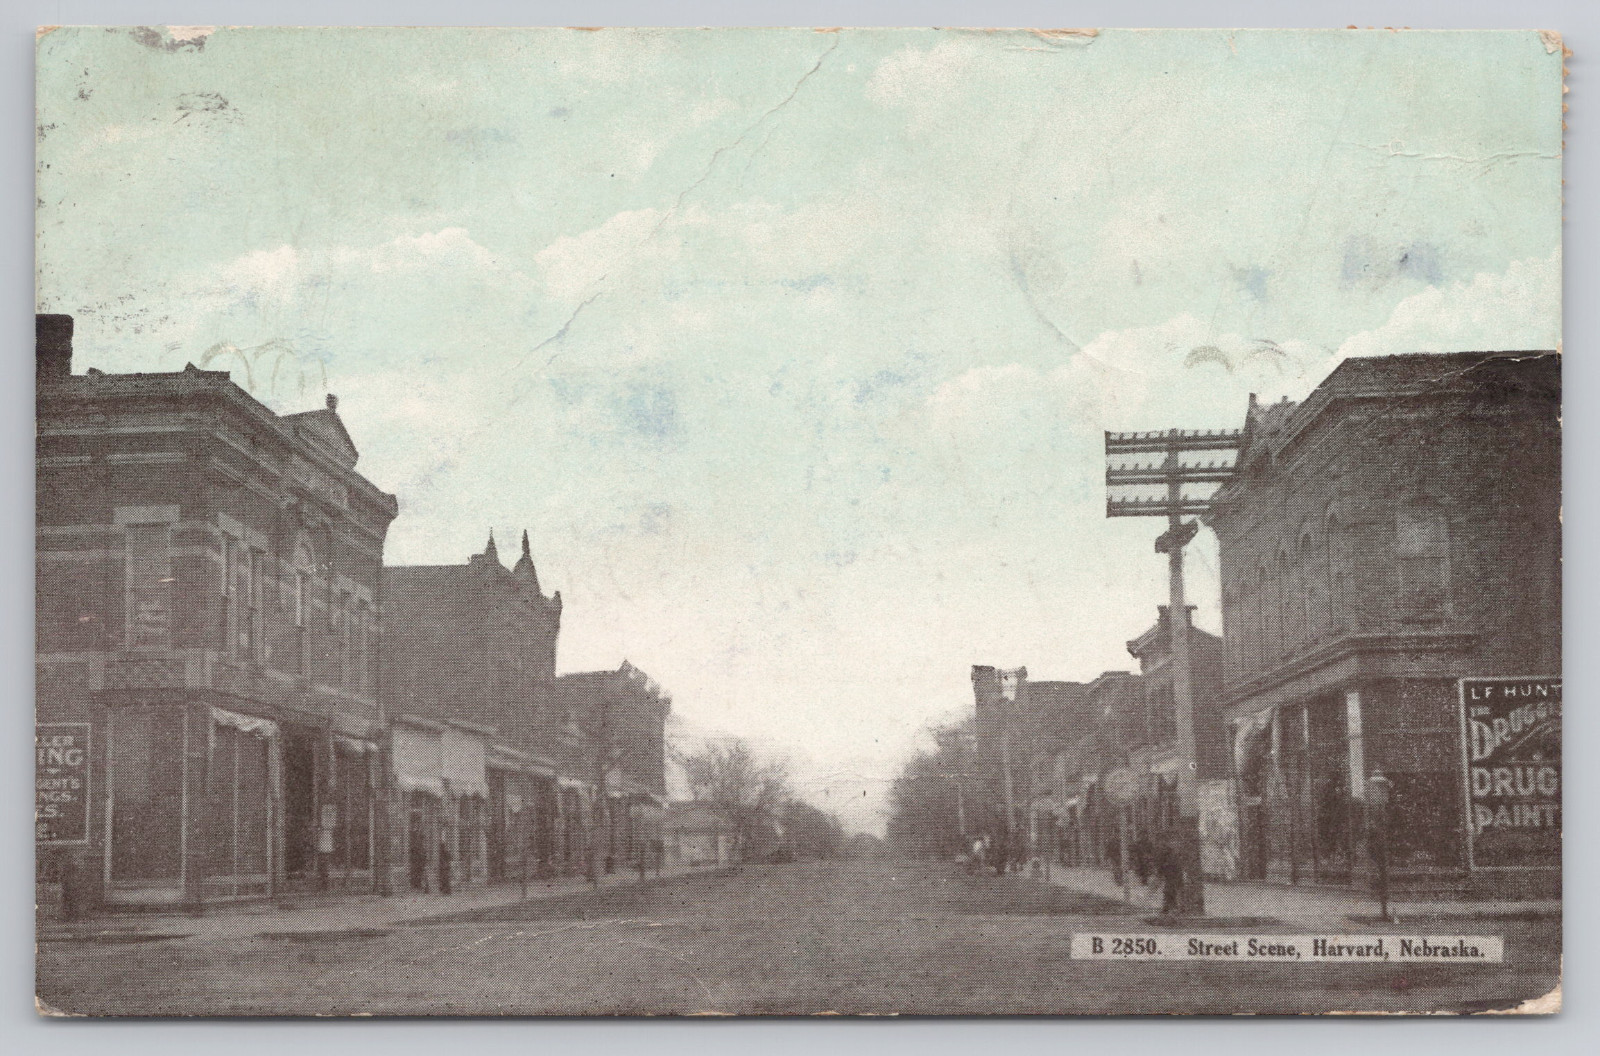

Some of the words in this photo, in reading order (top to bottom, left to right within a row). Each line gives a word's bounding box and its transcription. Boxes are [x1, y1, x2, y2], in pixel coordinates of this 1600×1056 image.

[1504, 684, 1562, 697] HUNT
[39, 735, 74, 747] LER
[1468, 703, 1562, 761] DRUGGI
[38, 748, 83, 767] ING
[1472, 767, 1558, 796] DRUG
[1473, 804, 1559, 835] PAINT
